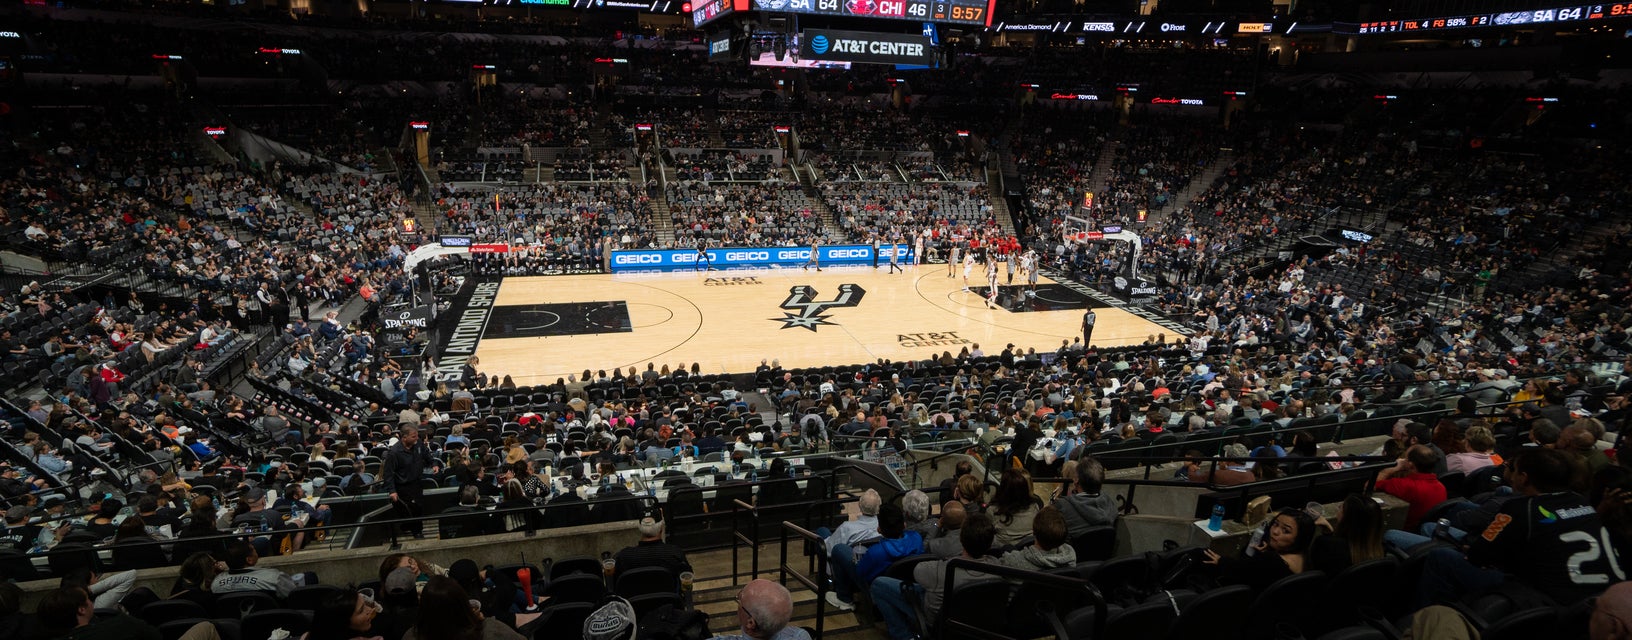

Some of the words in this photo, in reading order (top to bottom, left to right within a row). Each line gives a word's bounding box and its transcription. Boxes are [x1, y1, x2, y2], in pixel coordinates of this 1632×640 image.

[791, 0, 810, 9] SA
[818, 0, 838, 11] 64
[879, 1, 902, 15] CHI
[908, 3, 927, 16] 46
[937, 4, 944, 13] 3
[1593, 5, 1602, 13] 3
[952, 6, 983, 20] 9:57
[1532, 10, 1554, 22] SA
[1558, 8, 1581, 20] 64
[1433, 19, 1445, 28] FG
[1447, 18, 1467, 27] 58%
[1472, 17, 1479, 25] F
[1479, 16, 1487, 25] 2
[832, 39, 870, 54] AT&T
[871, 41, 924, 57] CENTER
[615, 253, 662, 265] GEICO
[725, 251, 769, 261] GEICO
[828, 249, 869, 259] GEICO
[467, 282, 499, 307] SPURS
[1131, 286, 1156, 295] SPALDING
[384, 317, 427, 329] SPALDING
[445, 308, 489, 353] ANTONIO
[896, 331, 960, 342] AT&T
[900, 339, 974, 348] CENTER
[434, 356, 470, 382] SAN
[219, 575, 258, 587] SPURS
